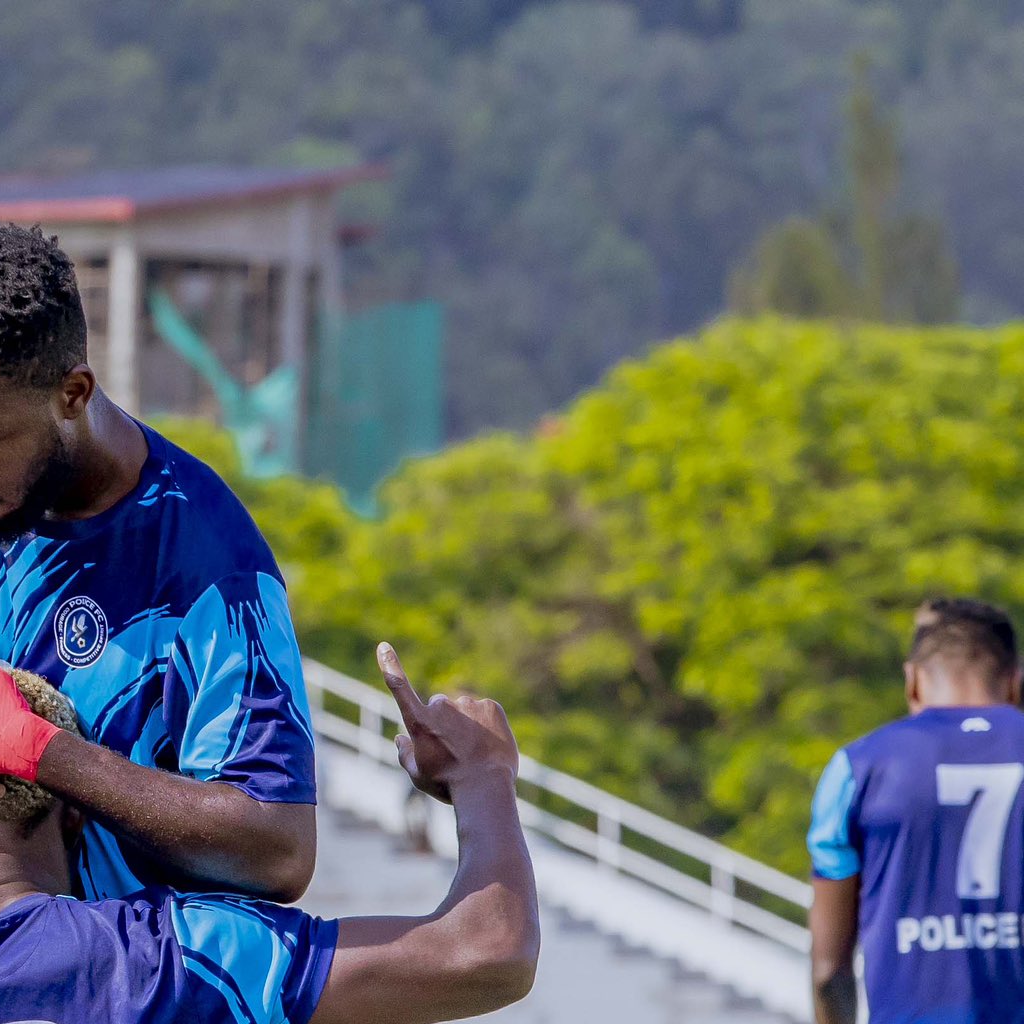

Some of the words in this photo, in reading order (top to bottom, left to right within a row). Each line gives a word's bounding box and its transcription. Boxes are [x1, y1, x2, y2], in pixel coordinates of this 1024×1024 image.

[68, 598, 95, 611] POLICE
[94, 609, 105, 622] FC
[936, 762, 1024, 899] 7
[896, 911, 1020, 954] POLICE
